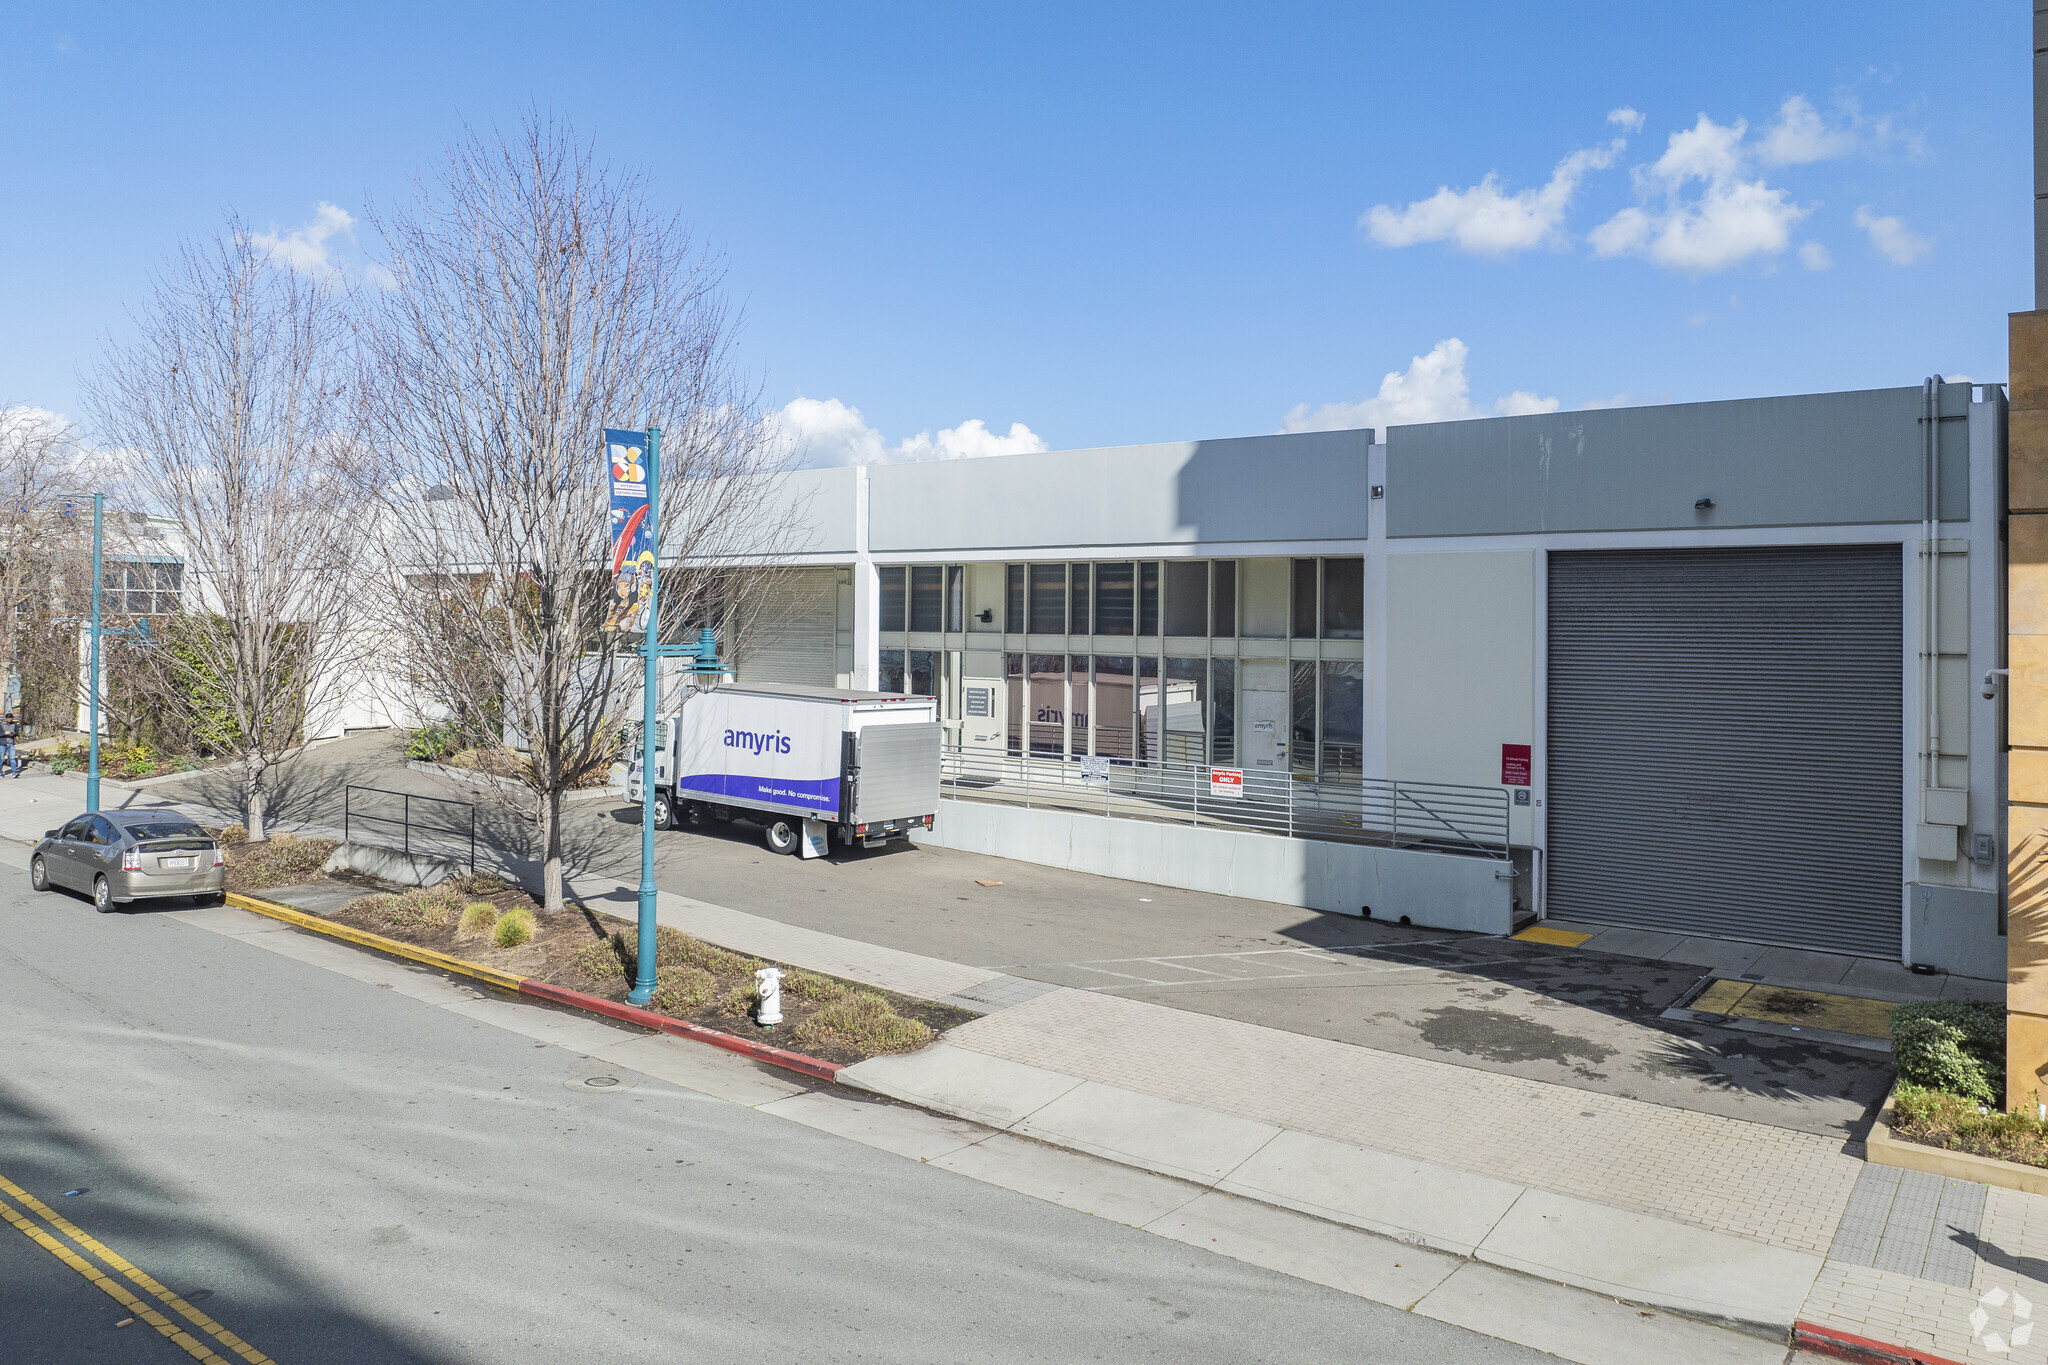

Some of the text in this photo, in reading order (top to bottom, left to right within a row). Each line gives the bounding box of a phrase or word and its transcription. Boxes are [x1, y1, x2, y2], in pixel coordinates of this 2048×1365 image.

[723, 729, 791, 756] amyris
[758, 785, 772, 793] Make
[788, 789, 796, 797] No
